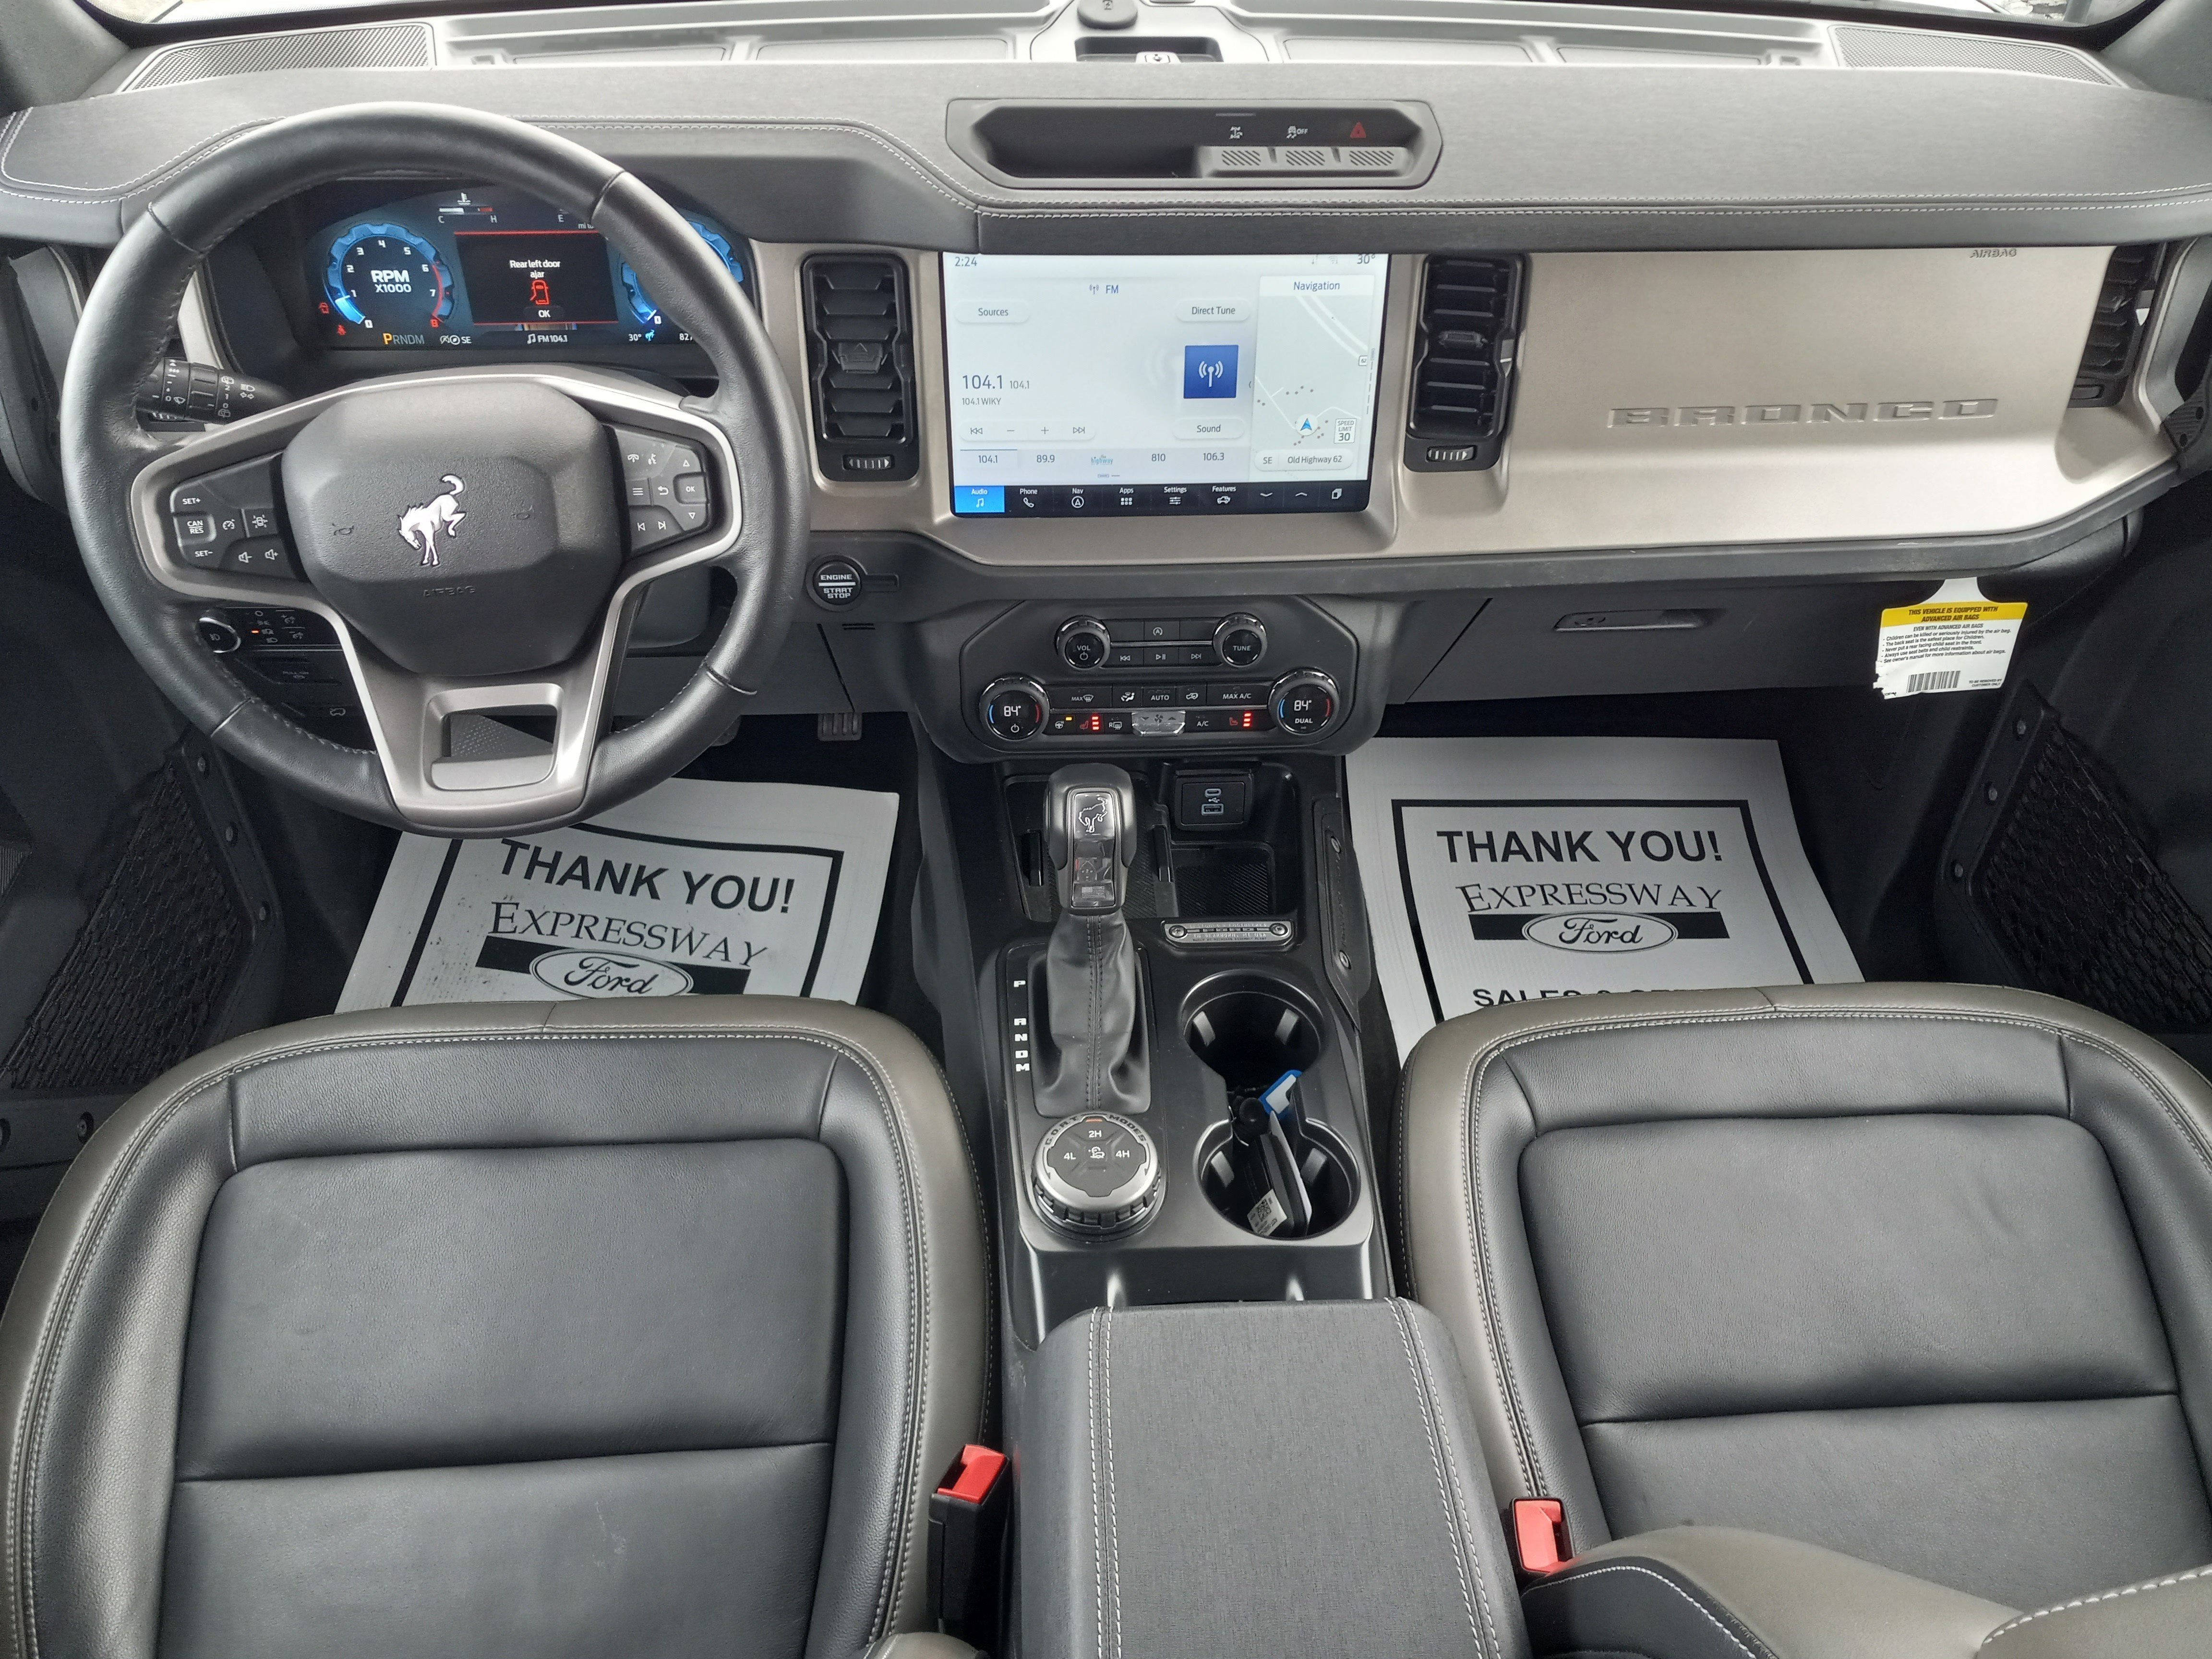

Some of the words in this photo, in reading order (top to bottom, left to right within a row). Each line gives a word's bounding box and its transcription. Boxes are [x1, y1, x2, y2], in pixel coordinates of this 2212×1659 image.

[378, 240, 386, 248] 4
[356, 247, 364, 255] 3
[403, 247, 411, 255] 5
[1970, 248, 2017, 258] AIRBAG
[509, 260, 527, 268] Rear
[528, 260, 542, 268] left
[543, 260, 561, 268] door
[955, 256, 978, 267] 2:24
[347, 264, 355, 273] 2
[421, 264, 429, 272] 6
[371, 270, 410, 283] RPM
[530, 270, 545, 279] ajar
[374, 284, 412, 293] X1000
[1106, 285, 1119, 294] FM
[1293, 280, 1340, 292] Navigation
[351, 289, 357, 298] 1
[429, 289, 436, 297] 7
[538, 310, 551, 318] OK
[978, 307, 1009, 317] Sources
[1191, 306, 1214, 316] Direct
[1216, 305, 1236, 315] Tune
[364, 319, 373, 328] 0
[549, 335, 568, 343] 104.1
[962, 374, 1003, 390] 104.1
[1010, 380, 1030, 390] 104.1
[962, 397, 980, 406] 104.1
[981, 397, 1002, 406] WIKY
[1606, 398, 1999, 429] BRONCO
[1196, 424, 1221, 433] Sound
[1338, 433, 1350, 441] 30
[978, 455, 998, 464] 104.1
[1036, 454, 1055, 464] 89.9
[1151, 453, 1166, 463] 810
[1202, 452, 1225, 461] 106.3
[1262, 457, 1273, 465] SE
[1301, 455, 1332, 465] Highway
[1333, 455, 1343, 463] 62
[1019, 487, 1038, 495] Phone
[1119, 487, 1134, 495] Apps
[1163, 486, 1188, 494] Settings
[1212, 485, 1237, 493] Features
[1436, 830, 1600, 863] THANK
[1607, 830, 1722, 862] YOU!
[500, 839, 669, 900] THANK
[681, 871, 795, 914] YOU!
[1558, 916, 1644, 946] Ford
[563, 956, 660, 996] Ford
[1014, 1034, 1028, 1042] N
[1016, 1063, 1030, 1071] M
[1109, 1114, 1147, 1142] MODES
[1088, 1130, 1102, 1138] 2H
[1115, 1150, 1130, 1158] 4H
